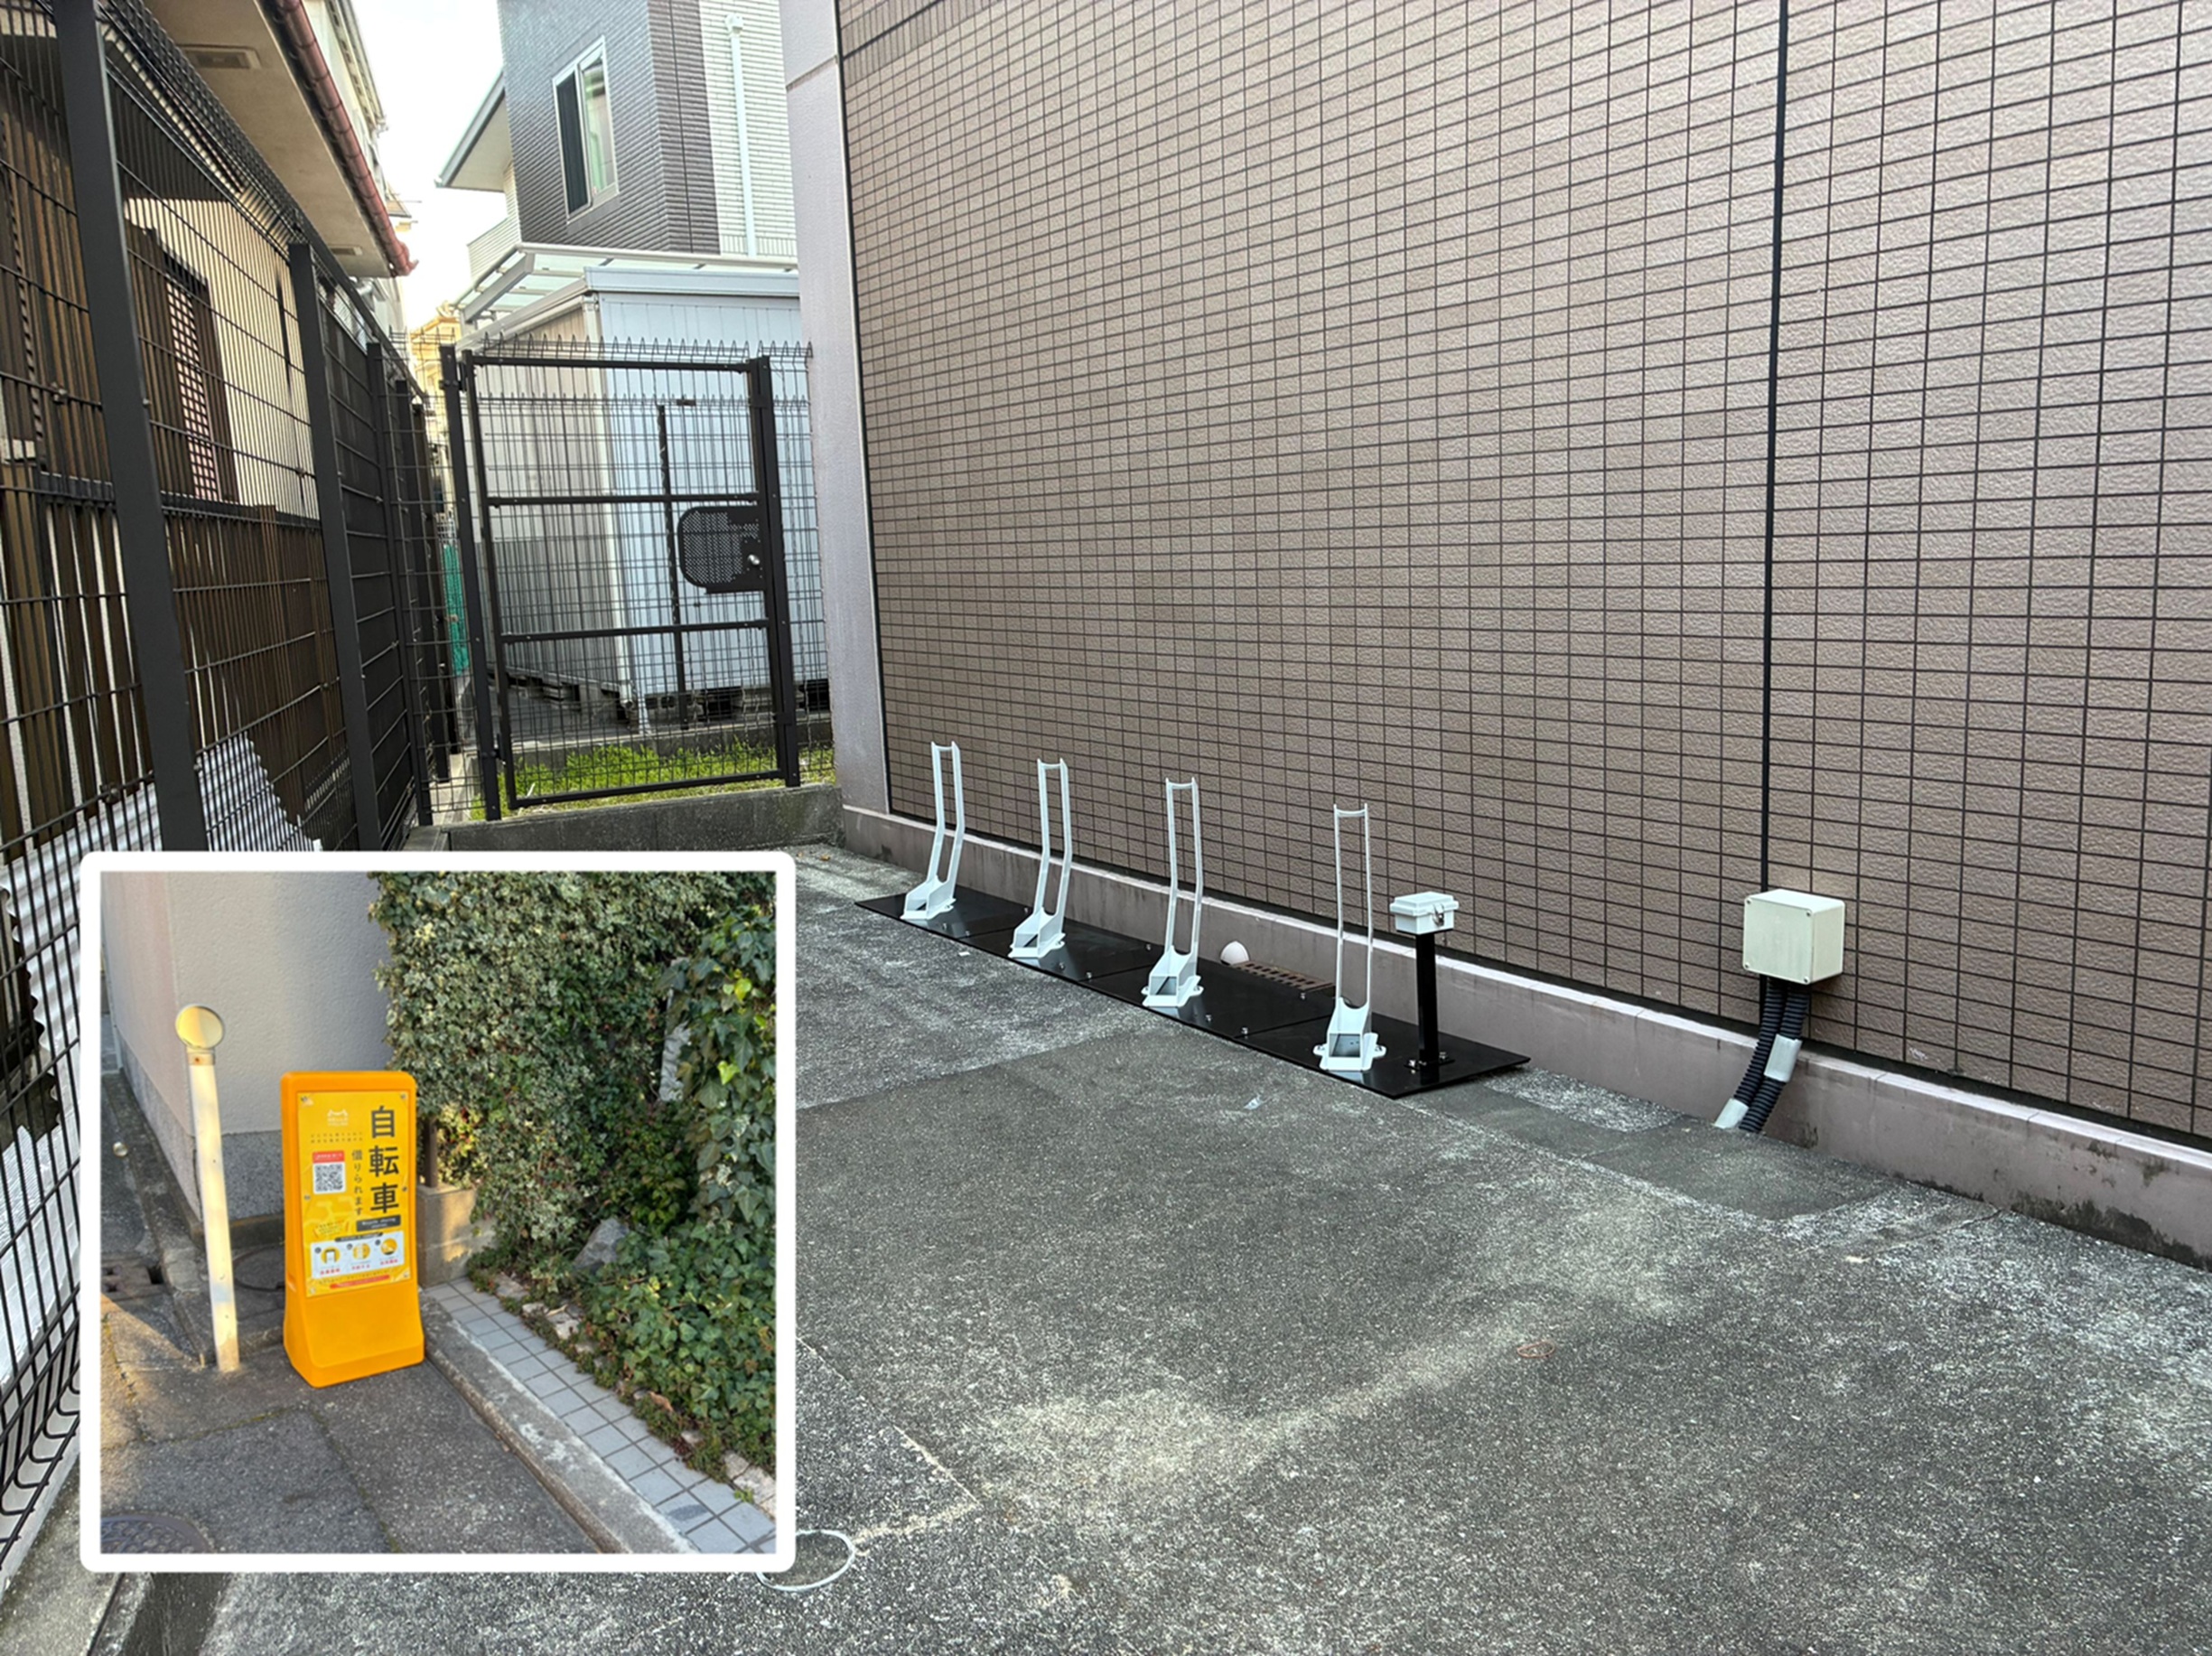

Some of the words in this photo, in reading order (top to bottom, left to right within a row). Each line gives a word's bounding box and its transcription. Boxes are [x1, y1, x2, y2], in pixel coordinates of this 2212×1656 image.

[351, 1149, 363, 1216] 借りられます
[369, 1105, 399, 1213] 自転車
